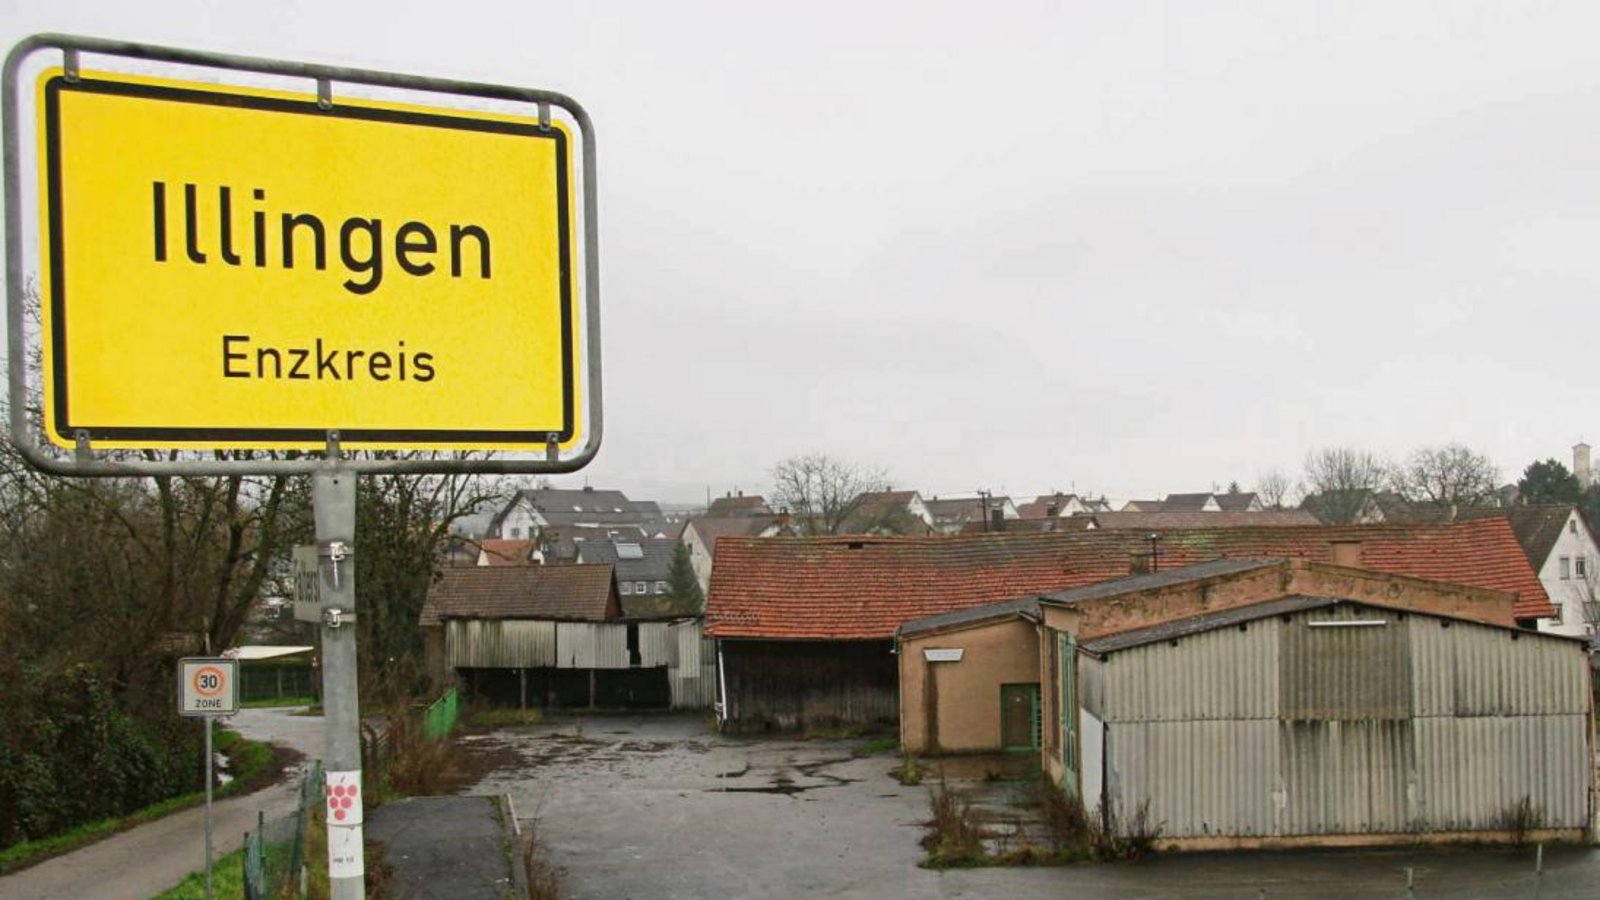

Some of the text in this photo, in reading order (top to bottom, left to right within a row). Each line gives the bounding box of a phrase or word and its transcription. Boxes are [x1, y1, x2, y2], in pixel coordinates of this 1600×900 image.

[153, 181, 491, 295] Illingen
[223, 335, 435, 382] Enzkreis
[200, 675, 217, 688] 30
[195, 699, 221, 708] ZONE
